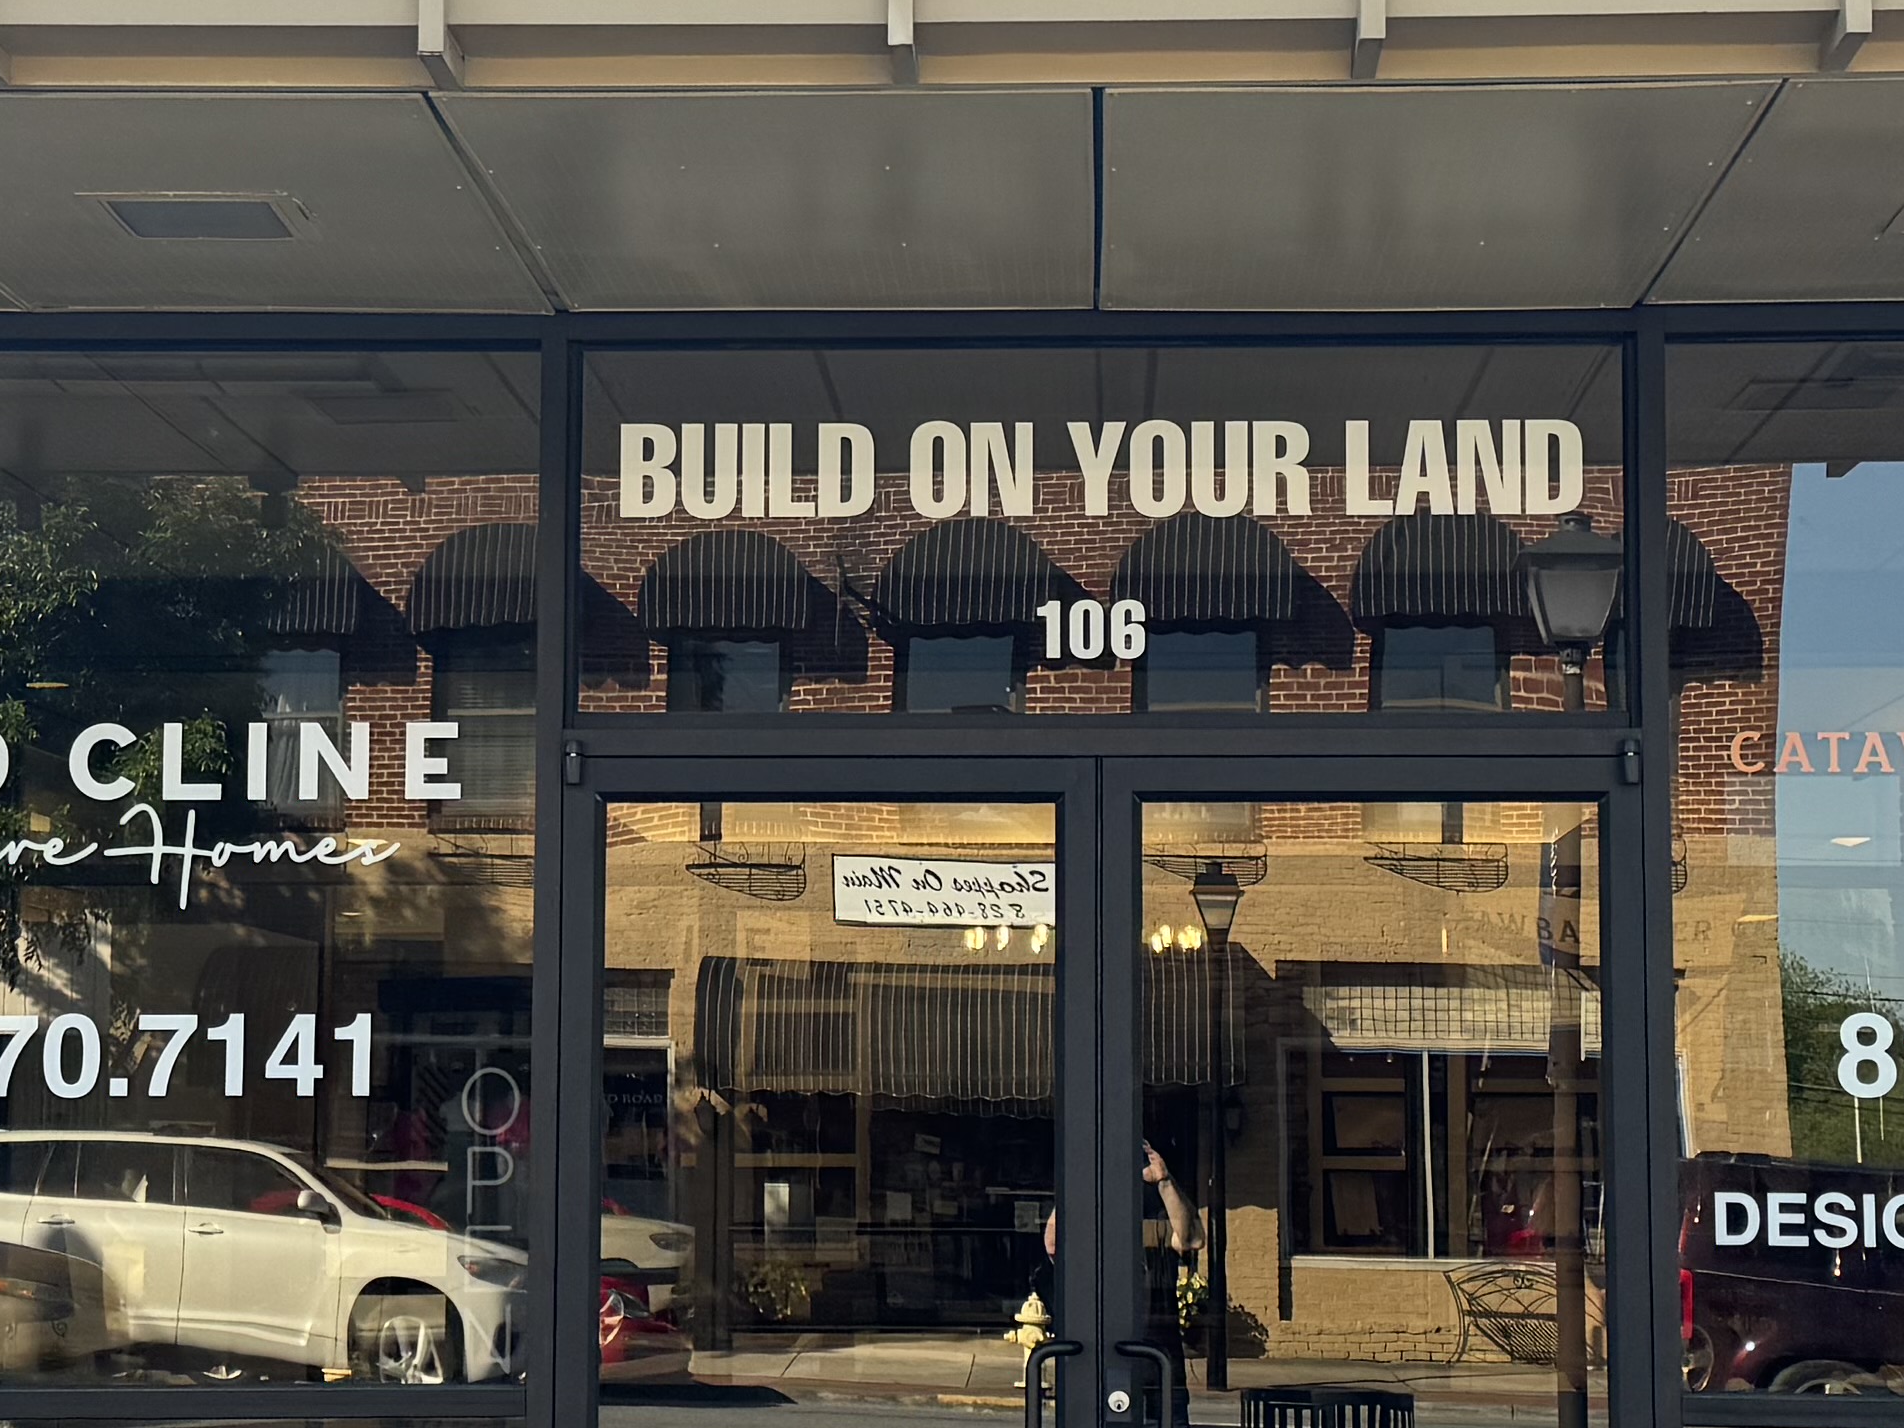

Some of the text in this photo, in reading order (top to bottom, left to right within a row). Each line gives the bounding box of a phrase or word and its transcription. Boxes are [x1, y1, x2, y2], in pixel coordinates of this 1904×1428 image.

[619, 418, 1584, 520] BUILD ON YOUR LAND
[1036, 599, 1146, 660] 106
[69, 722, 461, 801] CLINE
[104, 803, 401, 910] Homes
